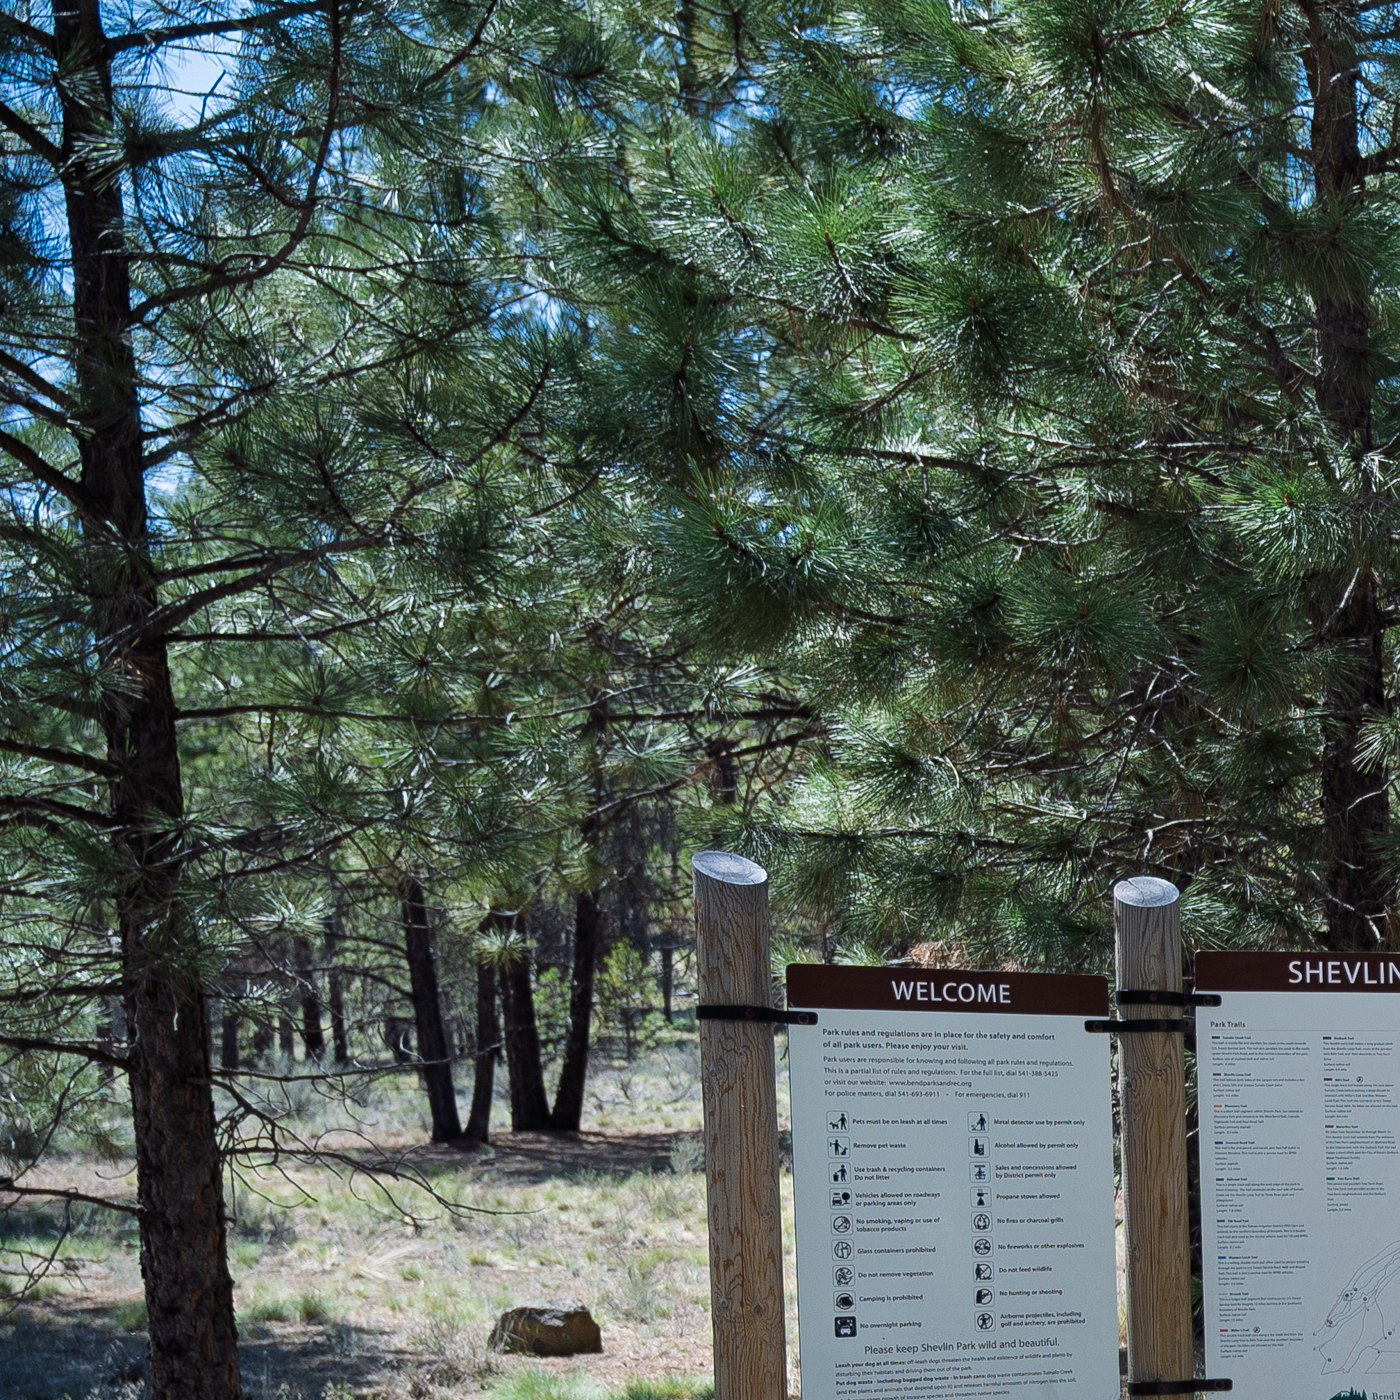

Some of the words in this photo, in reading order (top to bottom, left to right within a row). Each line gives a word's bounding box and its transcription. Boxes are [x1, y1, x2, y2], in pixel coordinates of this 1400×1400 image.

[892, 981, 1011, 1003] WELCOME
[877, 1030, 920, 1039] regulations
[943, 1031, 962, 1040] place
[989, 1032, 1010, 1041] safety
[843, 1041, 861, 1050] park
[868, 1057, 905, 1065] responsible
[916, 1057, 944, 1066] knowing
[958, 1058, 987, 1066] following
[996, 1058, 1010, 1066] park
[850, 1068, 871, 1076] partial
[836, 1090, 856, 1098] police
[966, 1091, 1006, 1099] emergencies,
[865, 1344, 894, 1354] Please
[896, 1343, 918, 1355] keep
[920, 1341, 954, 1352] Shevlin
[956, 1340, 976, 1350] Park
[978, 1340, 997, 1349] wild
[999, 1339, 1016, 1348] and
[1018, 1337, 1060, 1348] beautiful.
[1372, 1392, 1394, 1400] Bend
